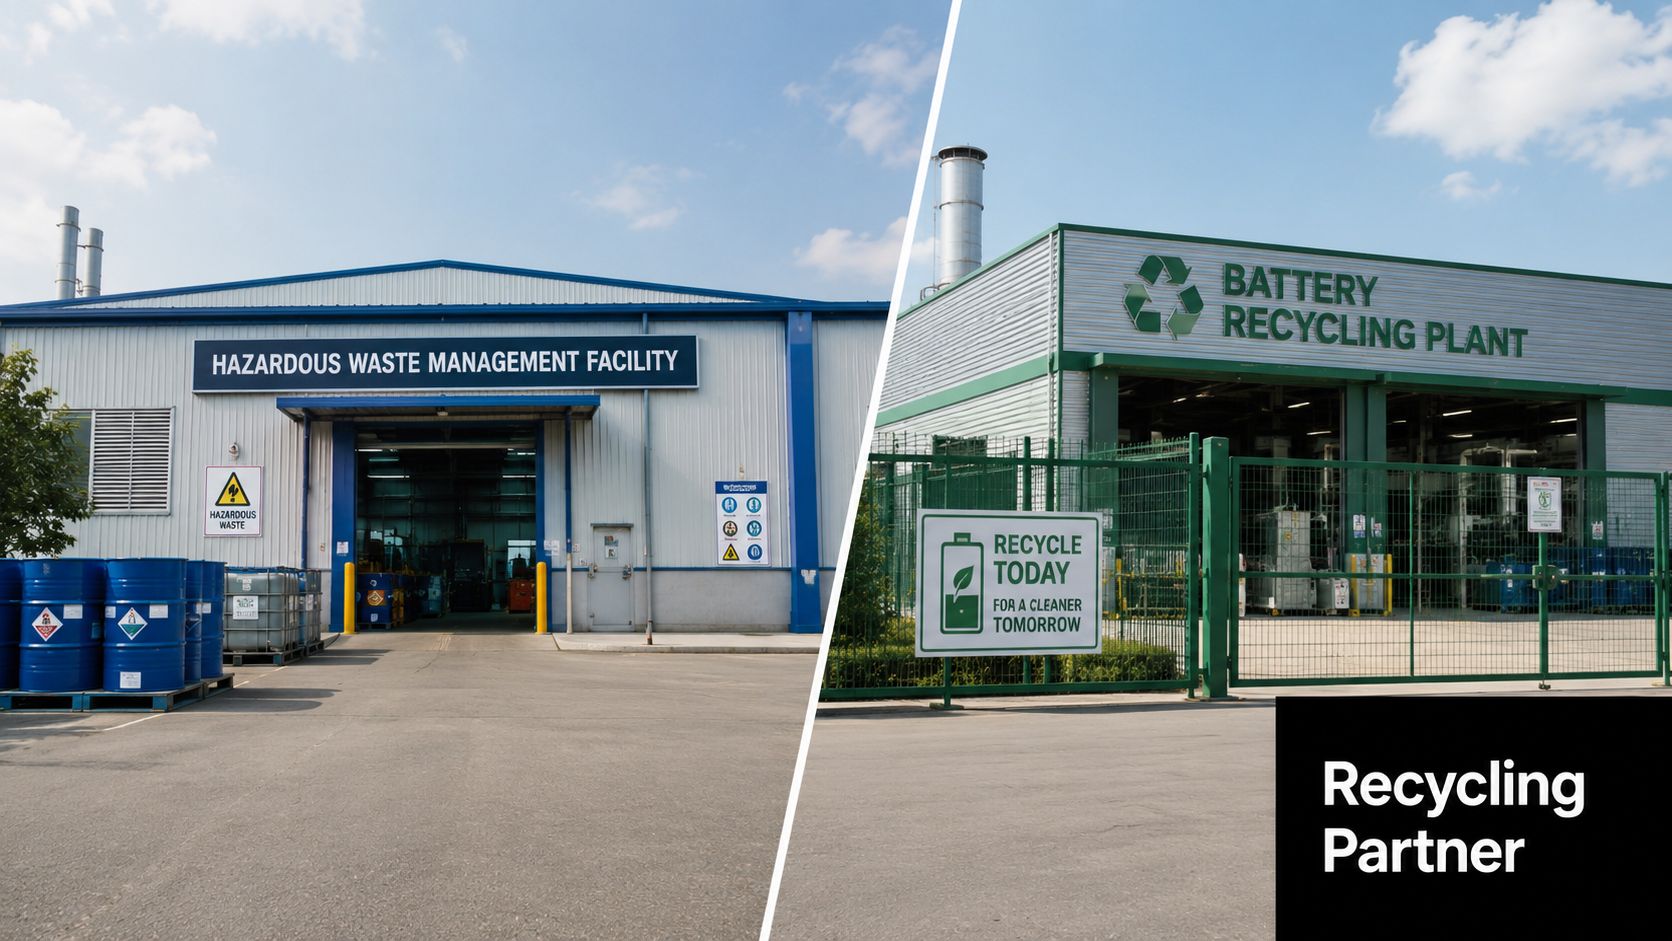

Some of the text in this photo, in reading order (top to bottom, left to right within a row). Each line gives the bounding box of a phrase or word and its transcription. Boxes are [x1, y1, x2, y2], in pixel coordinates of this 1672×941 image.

[1222, 262, 1379, 307] BATTERY
[1222, 304, 1529, 358] RECYCLING PLANT
[212, 349, 679, 376] HAZARDOUS WASTE MANAGEMENT FACILITY
[209, 510, 257, 519] HAZARDOUS
[219, 520, 245, 530] WASTE
[994, 533, 1082, 555] RECYCLE
[993, 560, 1071, 585] TODAY
[993, 598, 1082, 612] FOR A CLEANER
[993, 616, 1081, 634] TOMORROW
